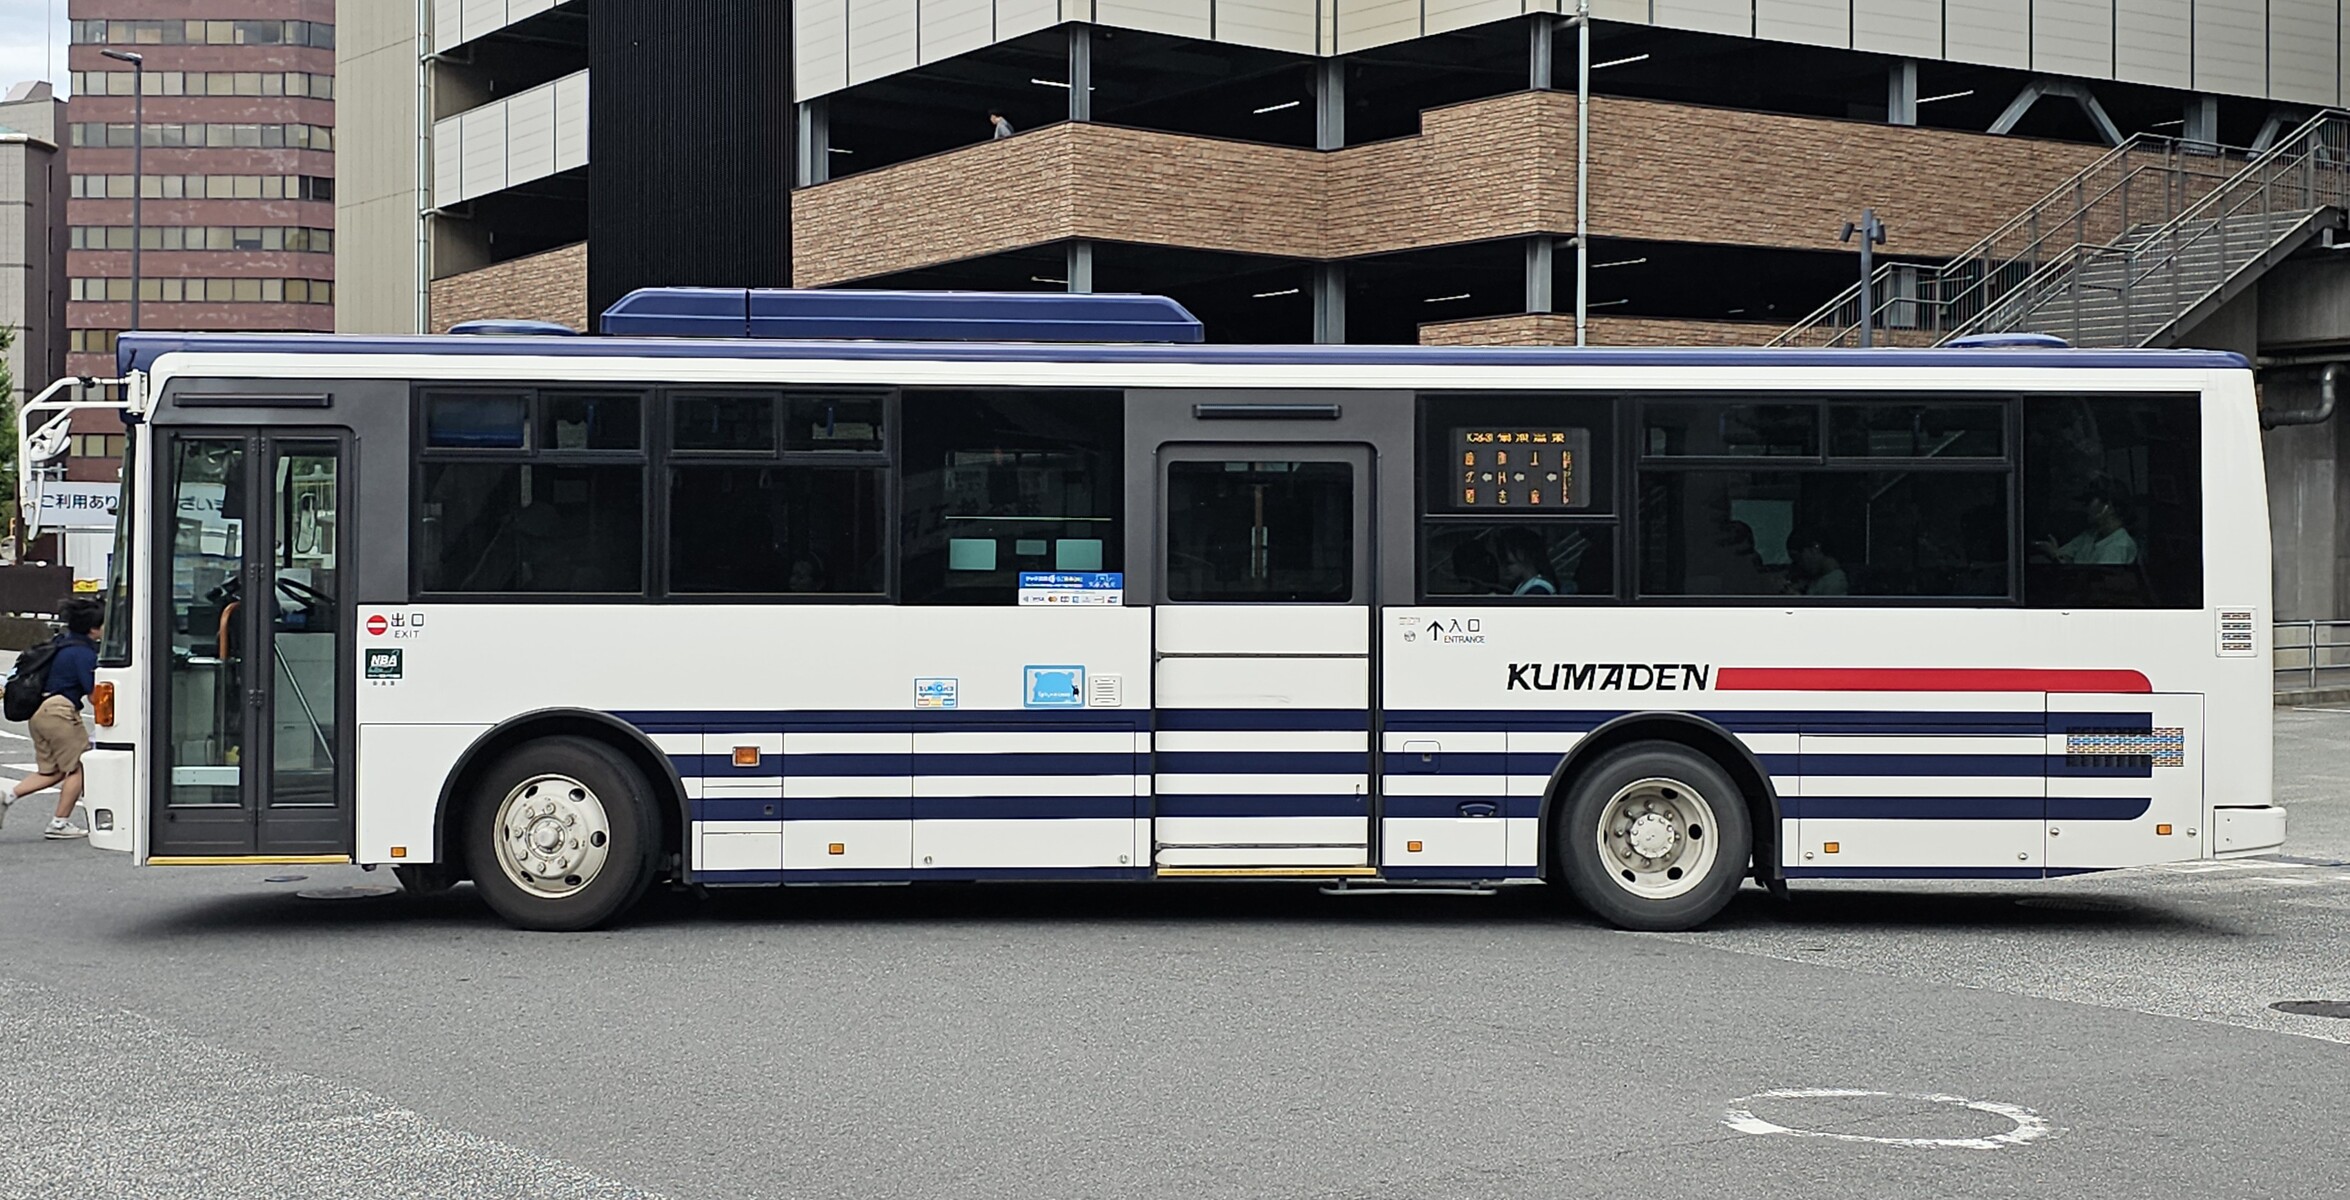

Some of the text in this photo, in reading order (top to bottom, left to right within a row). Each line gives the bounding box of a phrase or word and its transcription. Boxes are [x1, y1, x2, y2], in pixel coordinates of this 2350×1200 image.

[391, 612, 425, 627] 出口
[1449, 618, 1480, 632] 入口
[394, 629, 420, 639] EXIT
[1444, 635, 1486, 644] ENTRANCE
[370, 654, 398, 668] NBA
[1507, 663, 1710, 691] KUMADEN
